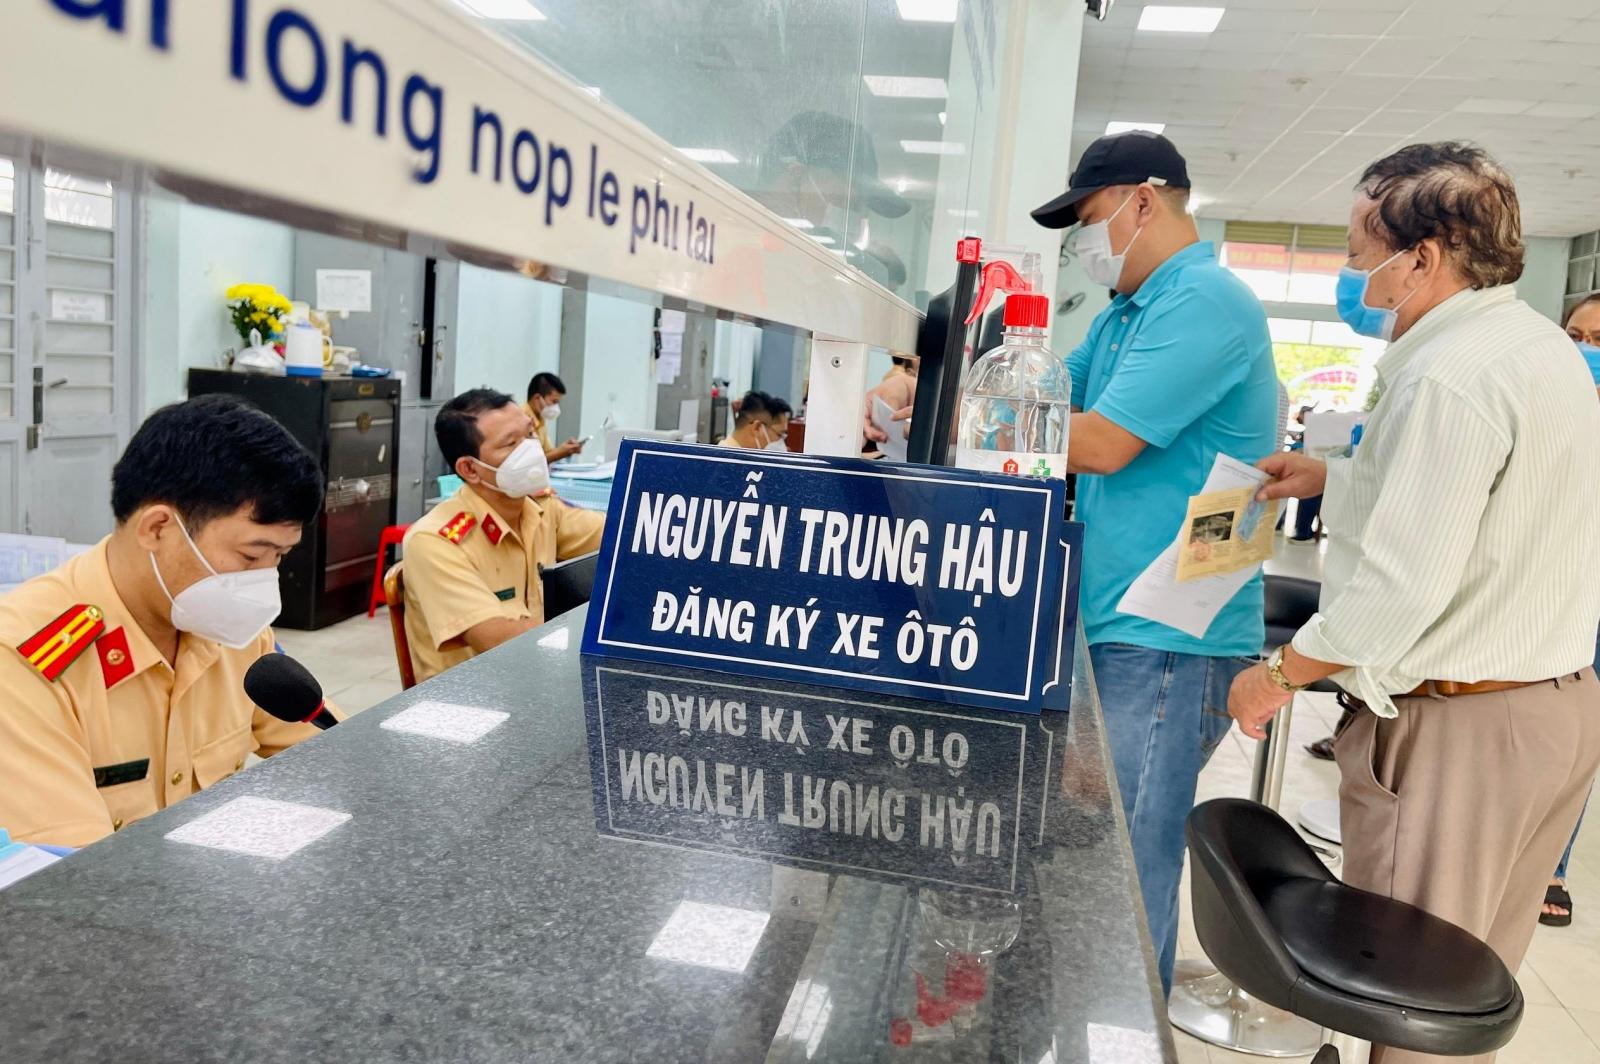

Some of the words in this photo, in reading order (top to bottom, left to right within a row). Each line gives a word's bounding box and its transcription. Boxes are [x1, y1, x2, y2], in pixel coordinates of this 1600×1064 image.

[229, 0, 444, 185] long
[470, 104, 573, 226] nop
[588, 144, 619, 226] le
[631, 471, 788, 571] NGUYỄN
[799, 508, 930, 587] TRUNG
[938, 508, 1028, 608] HẬU
[650, 587, 756, 644] ĐĂNG
[765, 597, 819, 650] KÝ
[829, 612, 884, 660] XE
[896, 609, 979, 671] ÔTÔ
